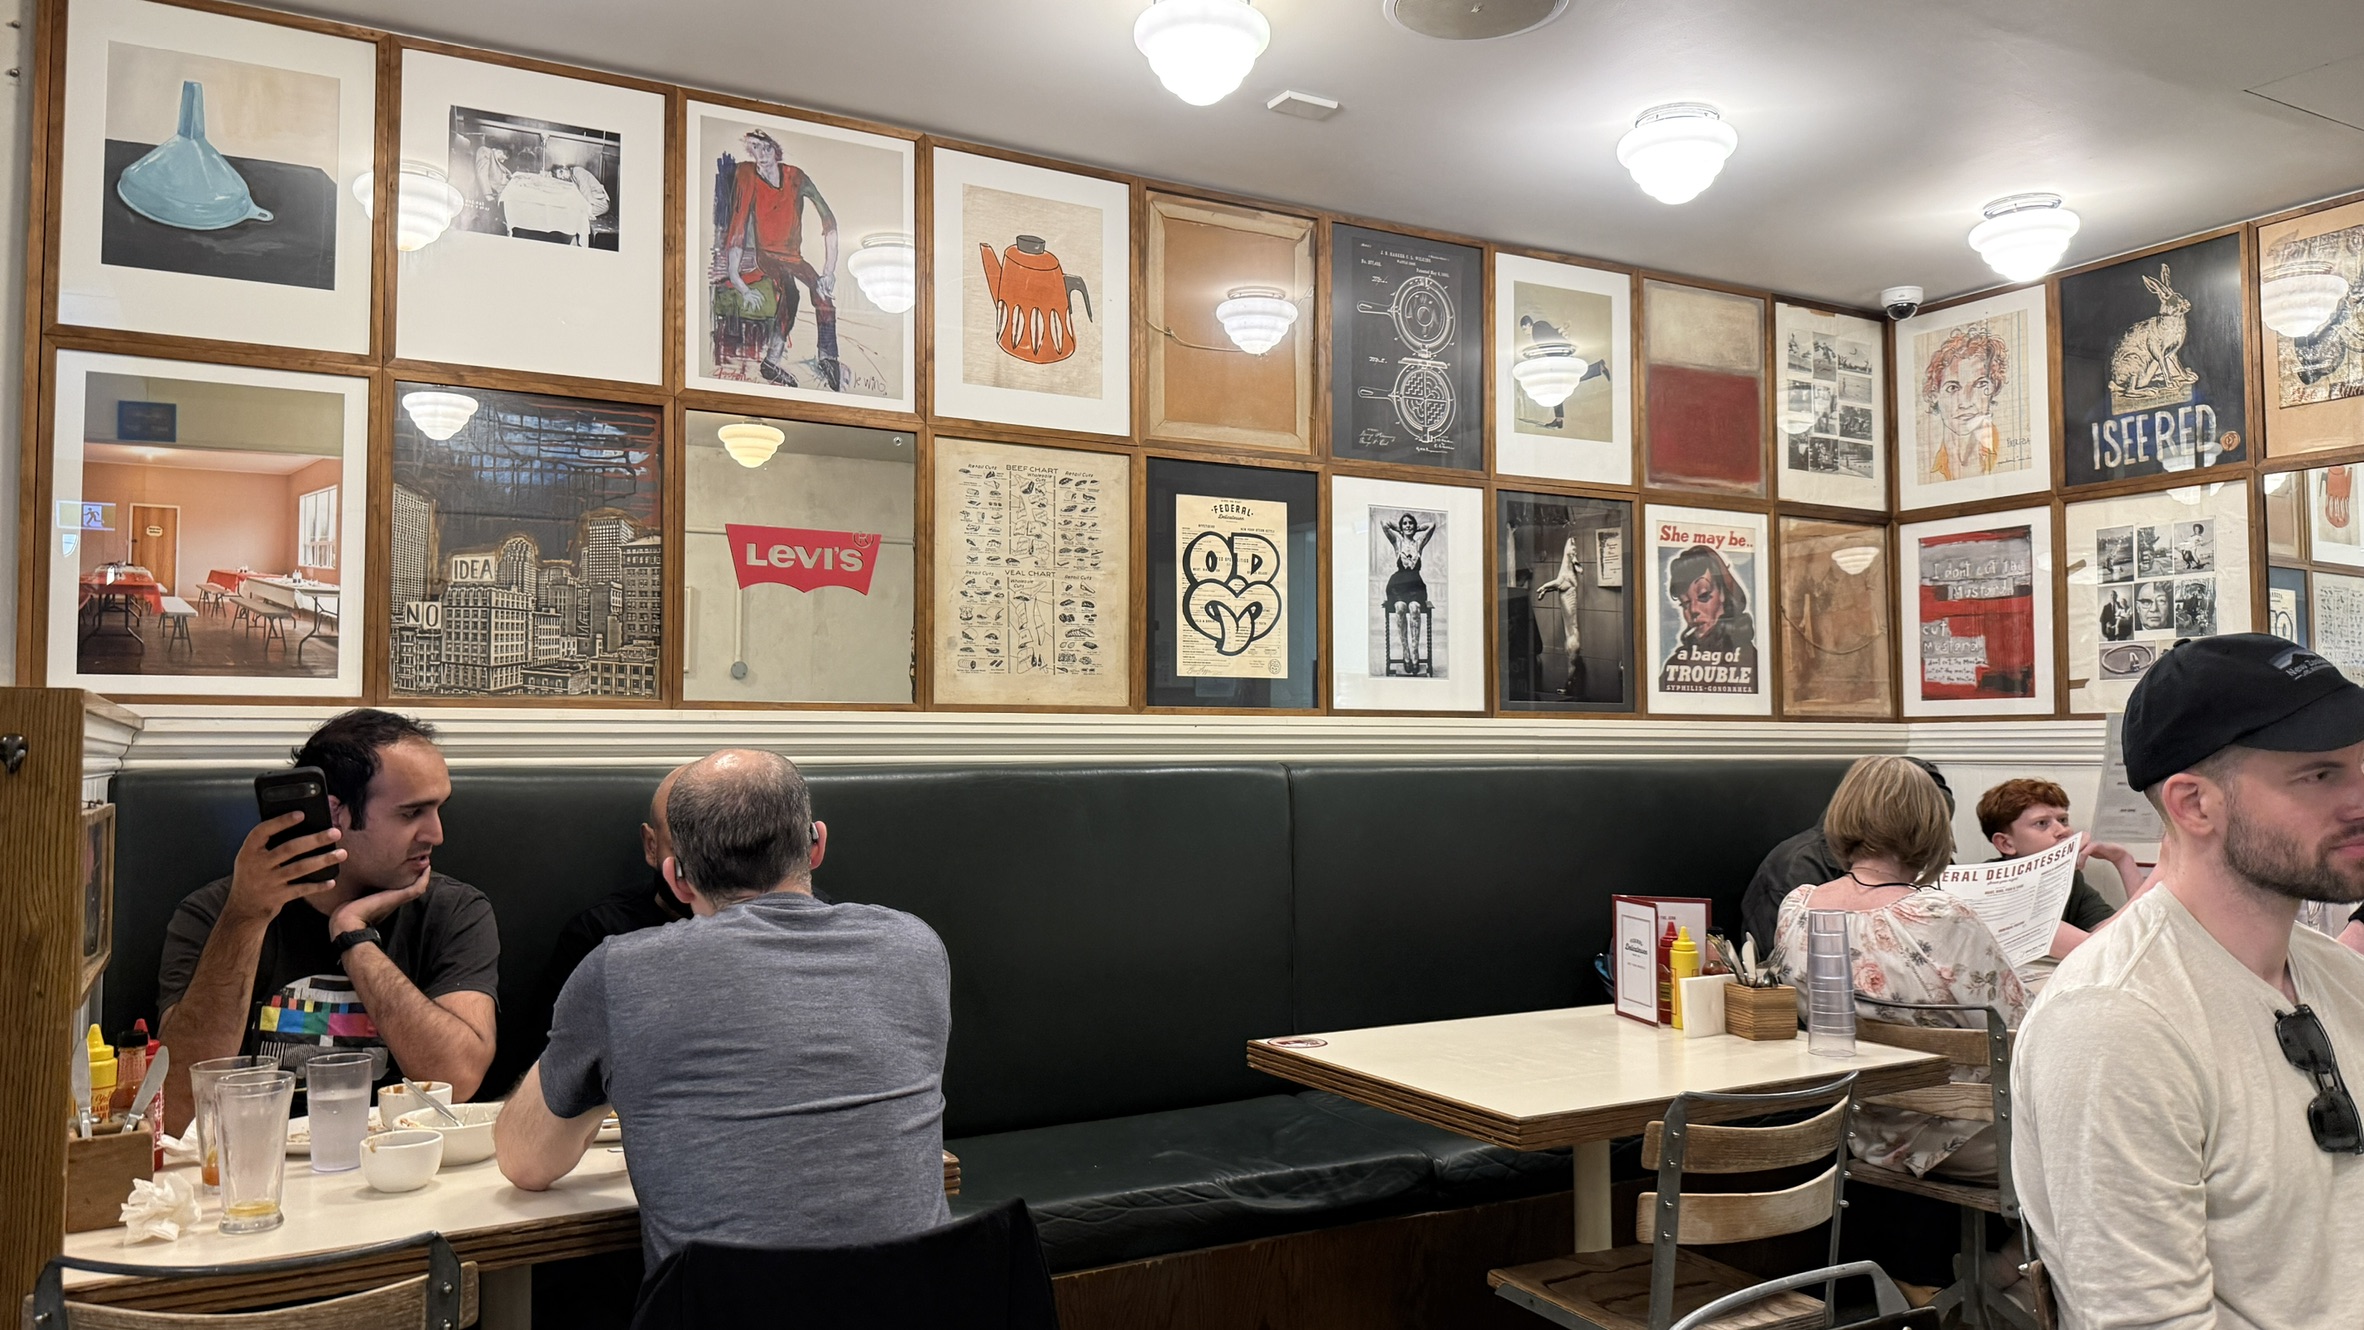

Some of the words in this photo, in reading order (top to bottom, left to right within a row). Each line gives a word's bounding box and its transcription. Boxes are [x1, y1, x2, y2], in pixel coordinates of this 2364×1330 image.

[2091, 422, 2100, 470] I
[2103, 414, 2150, 468] SEE
[2155, 404, 2217, 462] RED
[1029, 466, 1058, 474] CHART
[1213, 504, 1251, 517] FEDERAL
[1660, 524, 1689, 542] She
[1693, 533, 1725, 549] may
[454, 558, 493, 580] IDEA
[407, 603, 439, 627] NO
[1677, 649, 1688, 660] a
[1690, 644, 1722, 665] bag
[1724, 646, 1741, 662] of
[1666, 664, 1752, 683] TROUBLE
[1942, 871, 1978, 882] ERAL
[1986, 841, 2075, 880] DELICATESSEN
